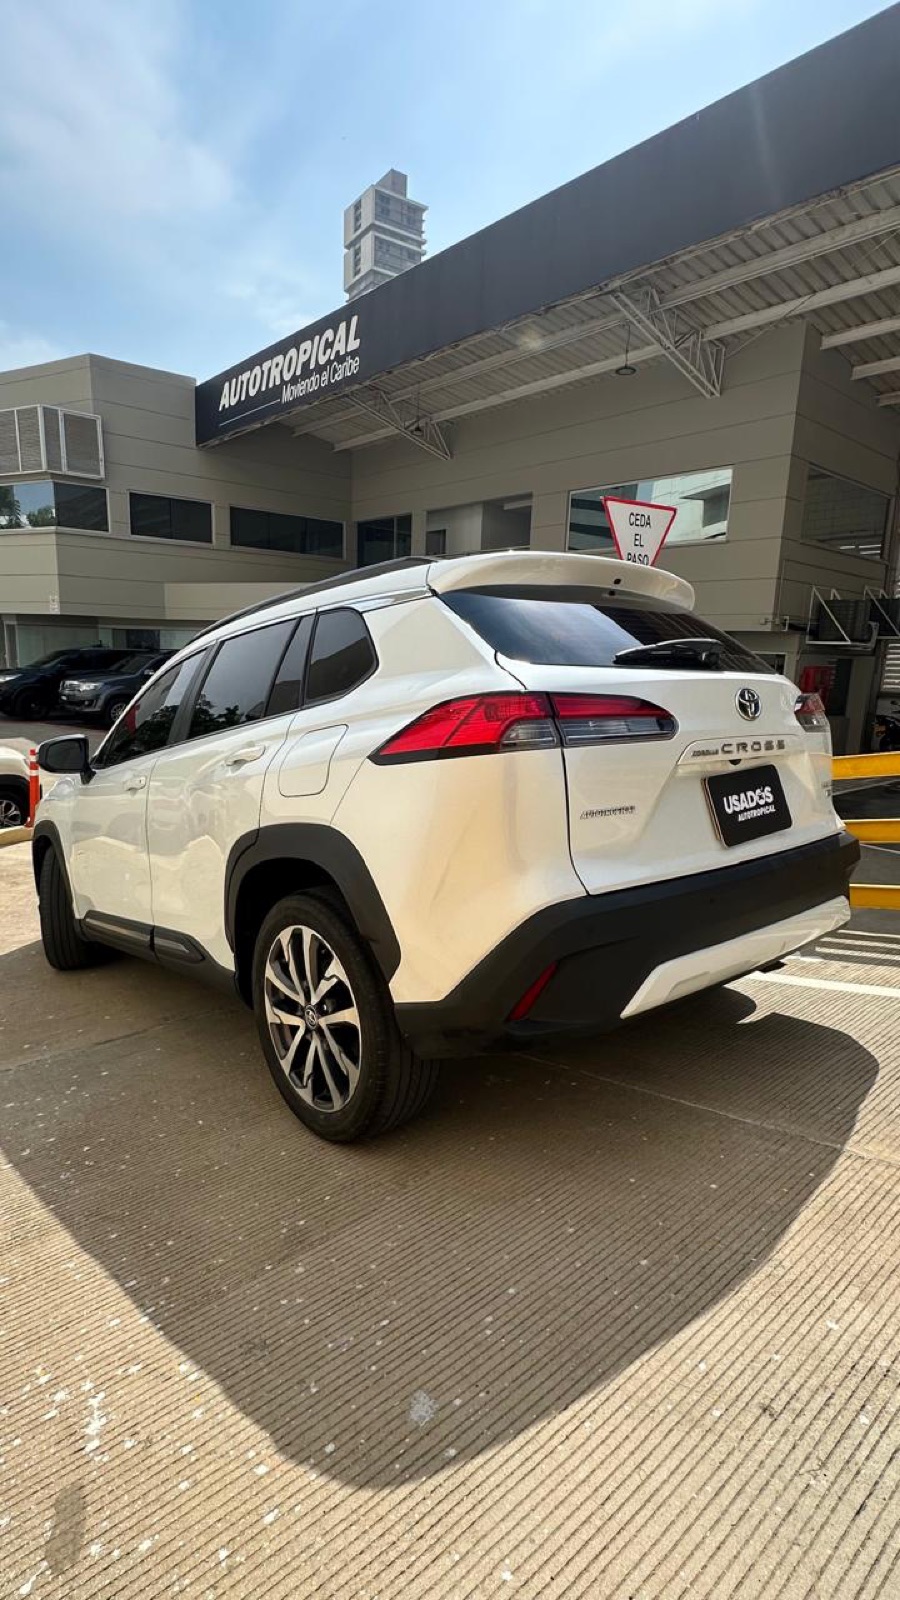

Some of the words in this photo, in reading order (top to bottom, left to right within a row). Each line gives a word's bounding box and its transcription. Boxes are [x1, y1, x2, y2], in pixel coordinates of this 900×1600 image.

[219, 315, 360, 411] AUTOTROPICAL
[282, 371, 320, 404] Moviendo
[321, 366, 330, 387] el
[330, 355, 360, 383] Caribe
[628, 511, 651, 528] CEDA
[633, 533, 644, 547] EL
[721, 740, 785, 754] CROSS
[723, 785, 774, 814] USADOS
[738, 804, 776, 821] AUTOTROPICAL
